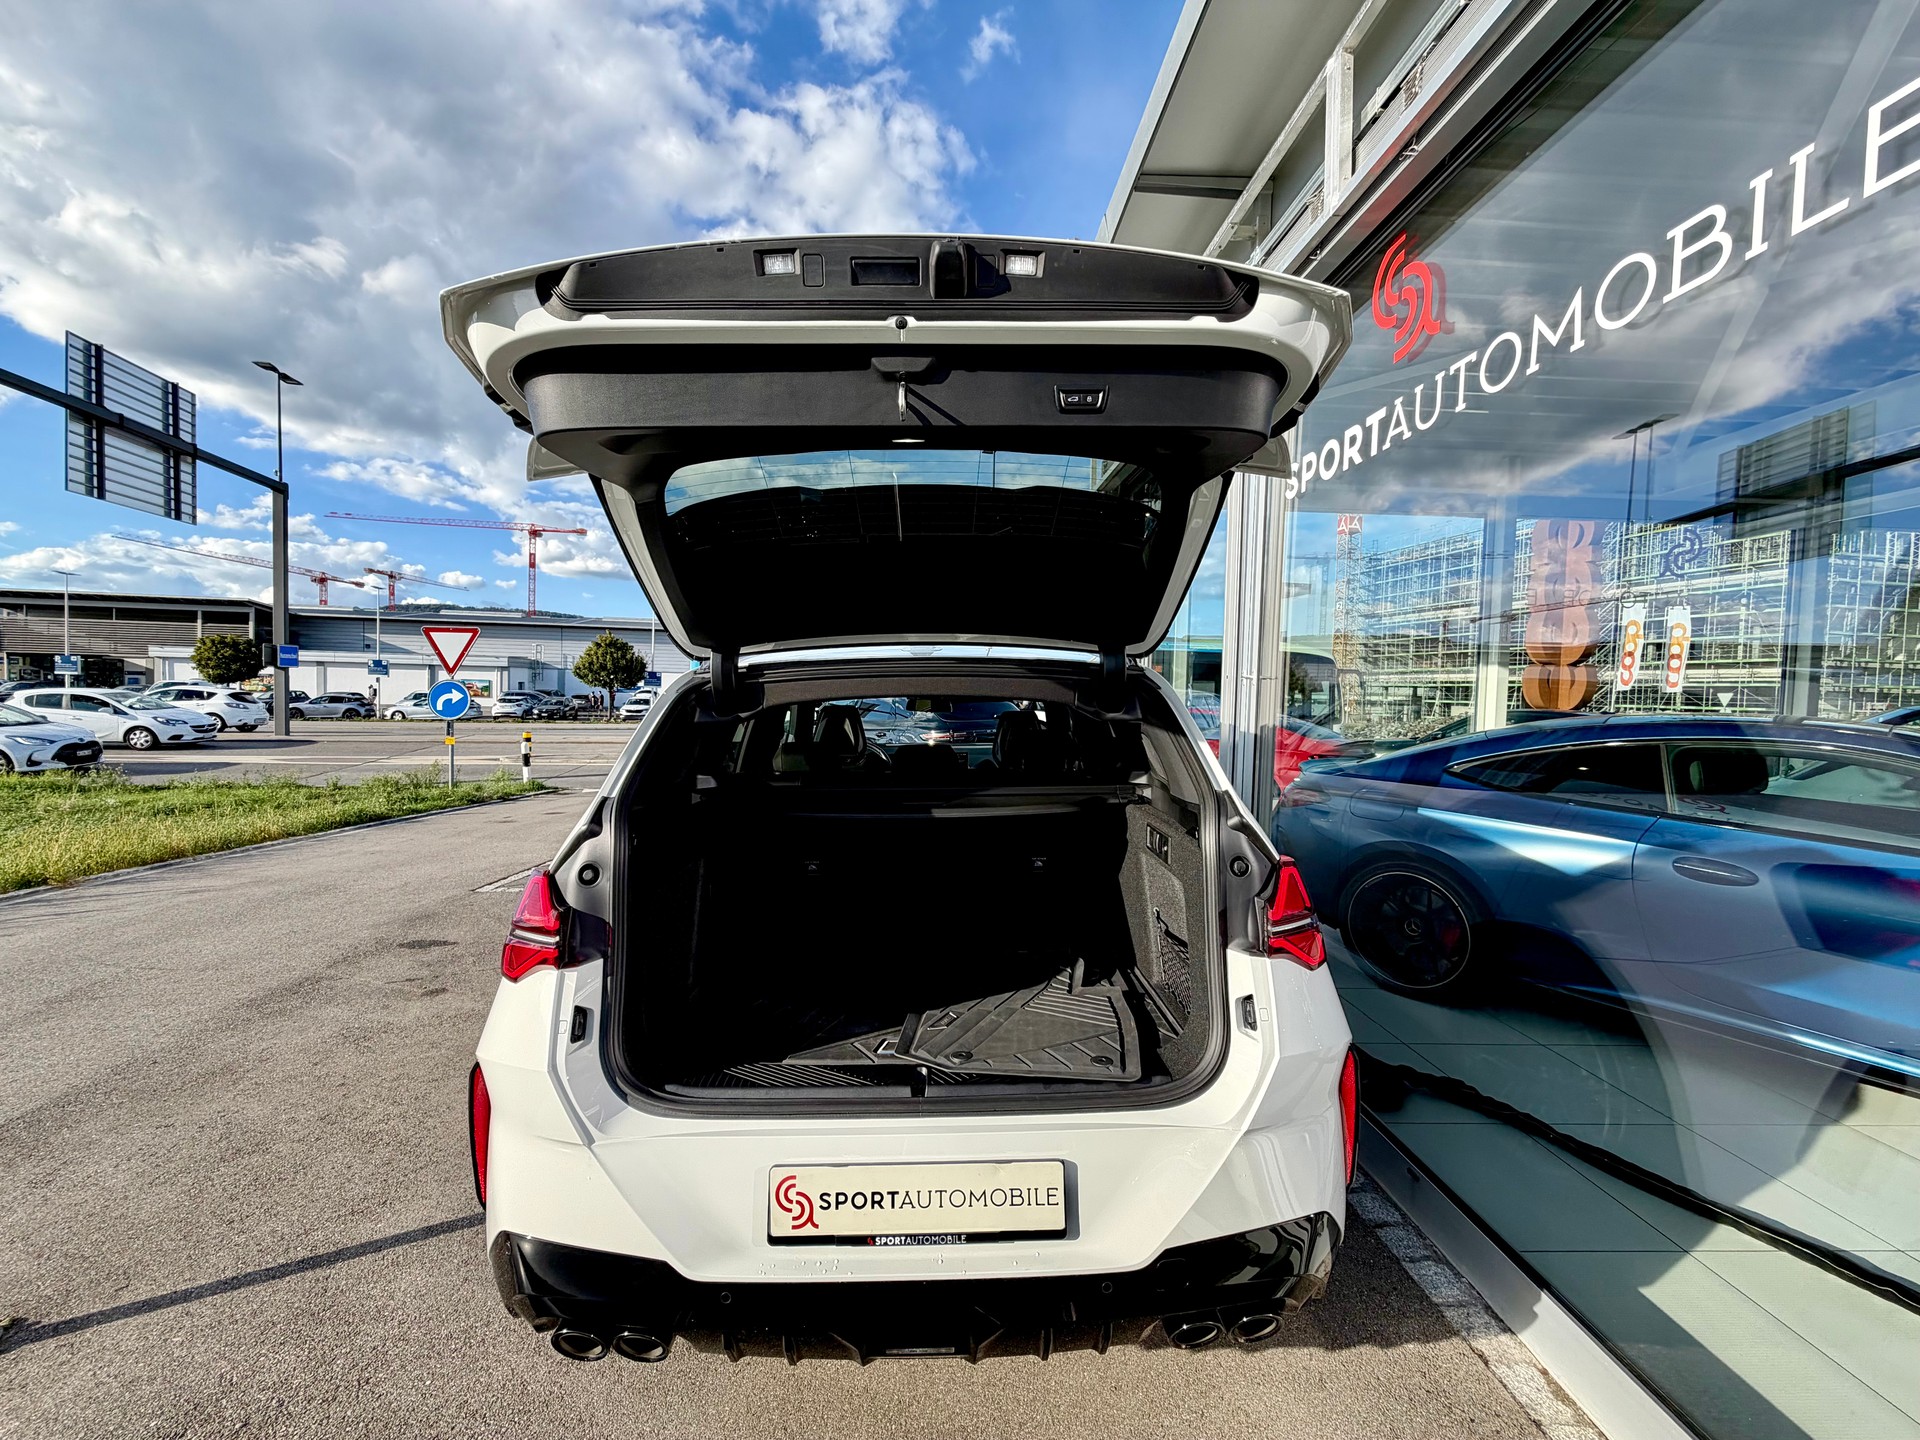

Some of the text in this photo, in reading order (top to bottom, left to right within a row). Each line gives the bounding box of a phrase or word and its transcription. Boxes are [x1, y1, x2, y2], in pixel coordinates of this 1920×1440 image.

[1285, 76, 1920, 500] SPORTAUTOMOBILE
[818, 1187, 1059, 1211] SPORTAUTOMOBILE
[875, 1235, 967, 1246] SPORTAUTOMOBILE
